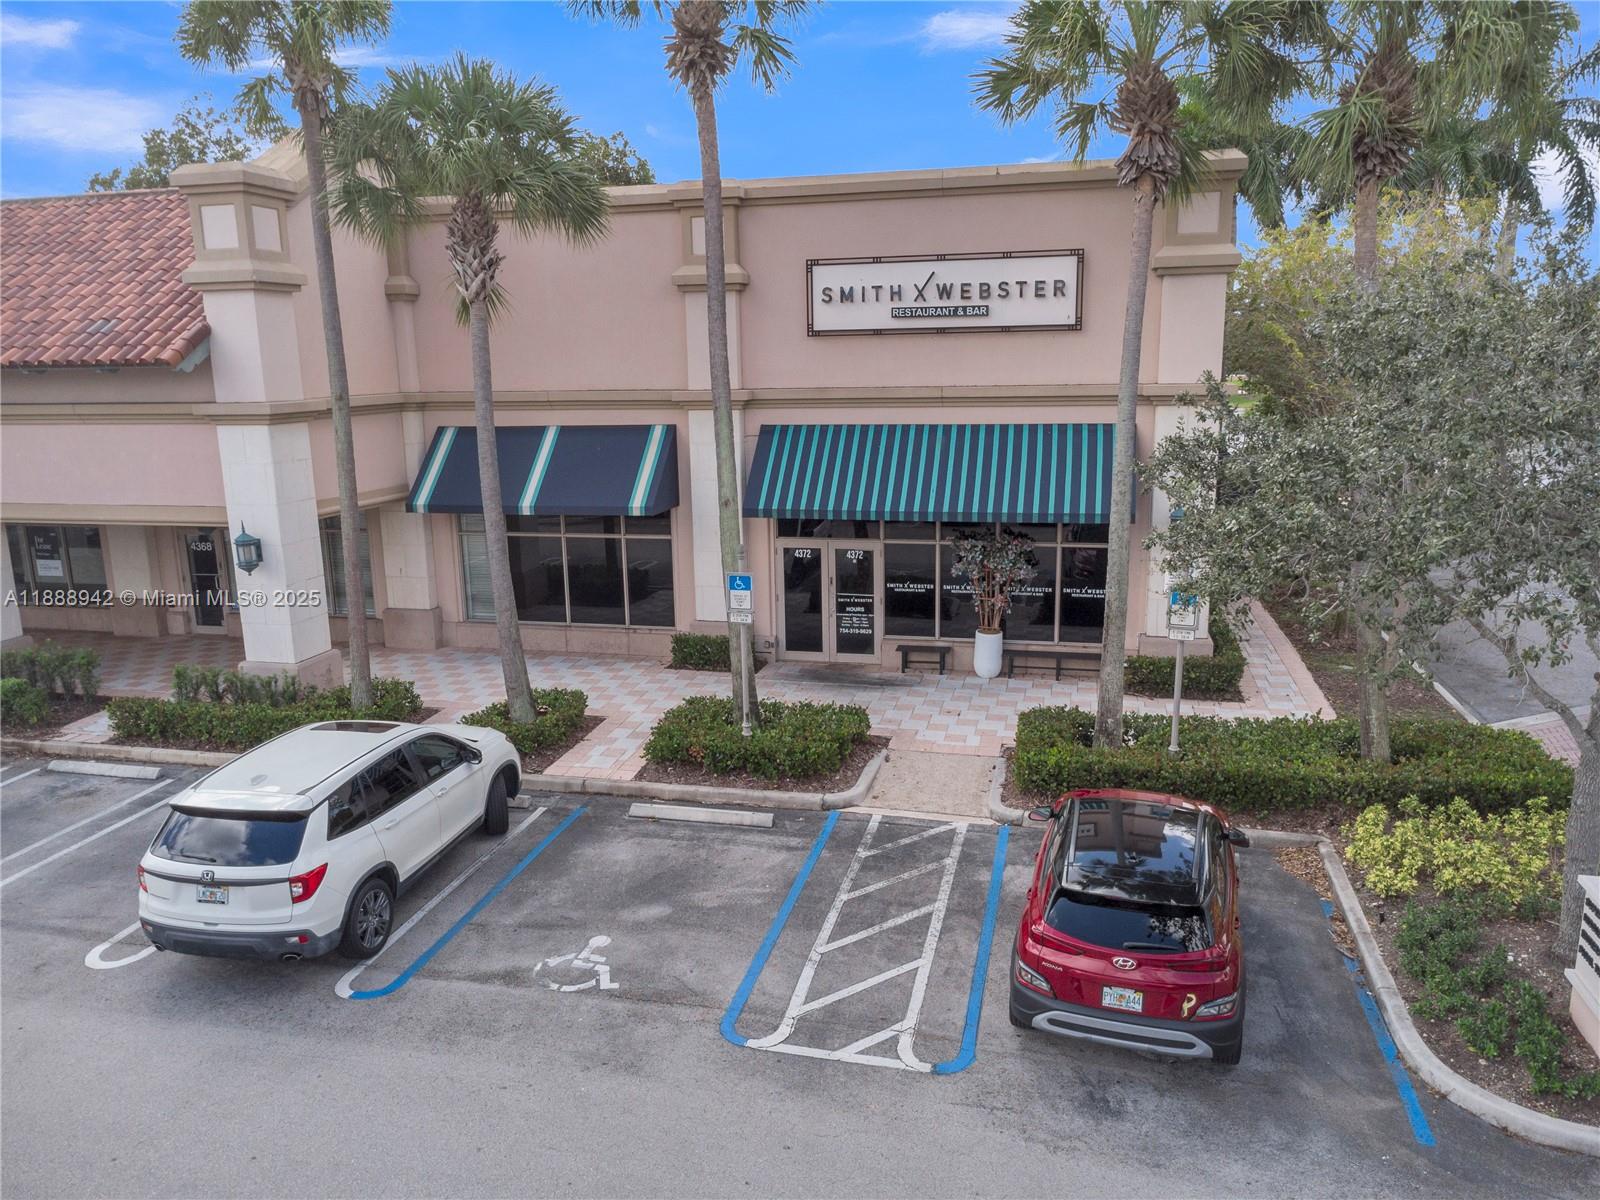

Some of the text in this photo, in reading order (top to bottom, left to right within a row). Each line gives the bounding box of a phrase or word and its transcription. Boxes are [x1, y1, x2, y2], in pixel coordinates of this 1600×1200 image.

[821, 284, 902, 304] SMITH
[936, 279, 1067, 300] WEBSTER
[892, 306, 987, 317] RESTAURANT & BAR
[191, 542, 213, 551] 4368
[794, 549, 811, 558] 4372
[846, 550, 864, 559] 4372
